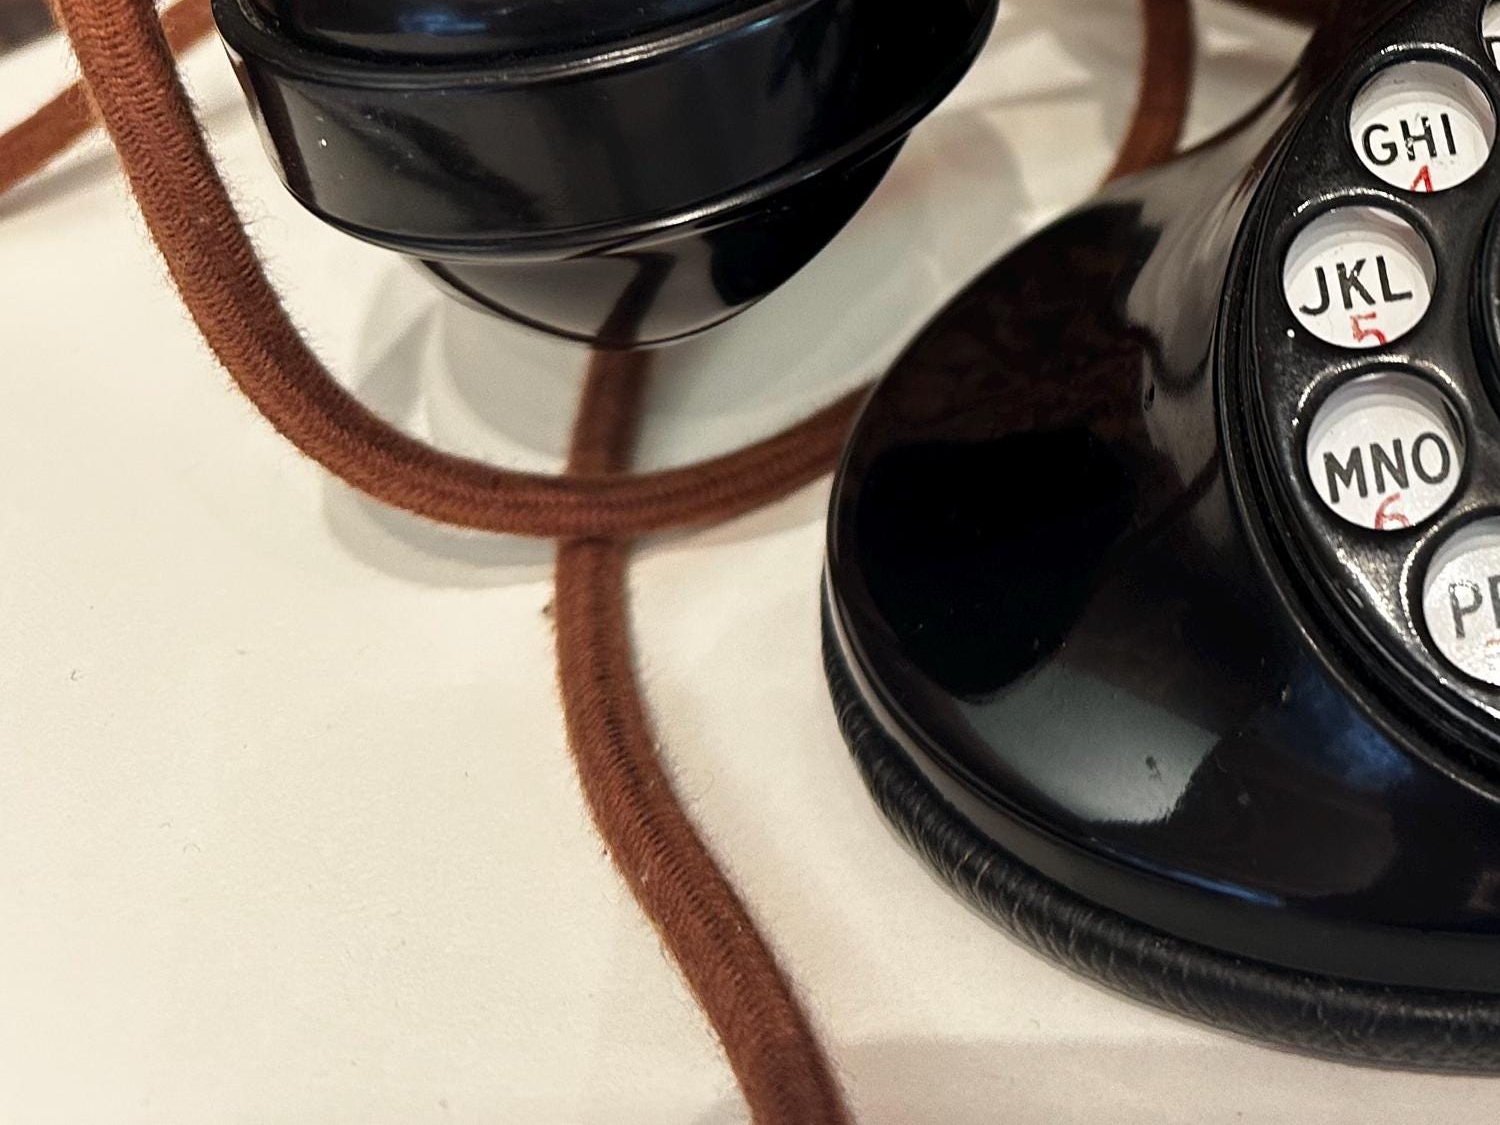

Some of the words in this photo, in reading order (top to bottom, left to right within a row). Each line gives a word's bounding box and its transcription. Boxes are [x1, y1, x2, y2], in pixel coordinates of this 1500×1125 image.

[1362, 113, 1458, 167] GHI
[1299, 256, 1413, 315] JKL
[1350, 313, 1387, 345] 5
[1323, 433, 1451, 504] MNO
